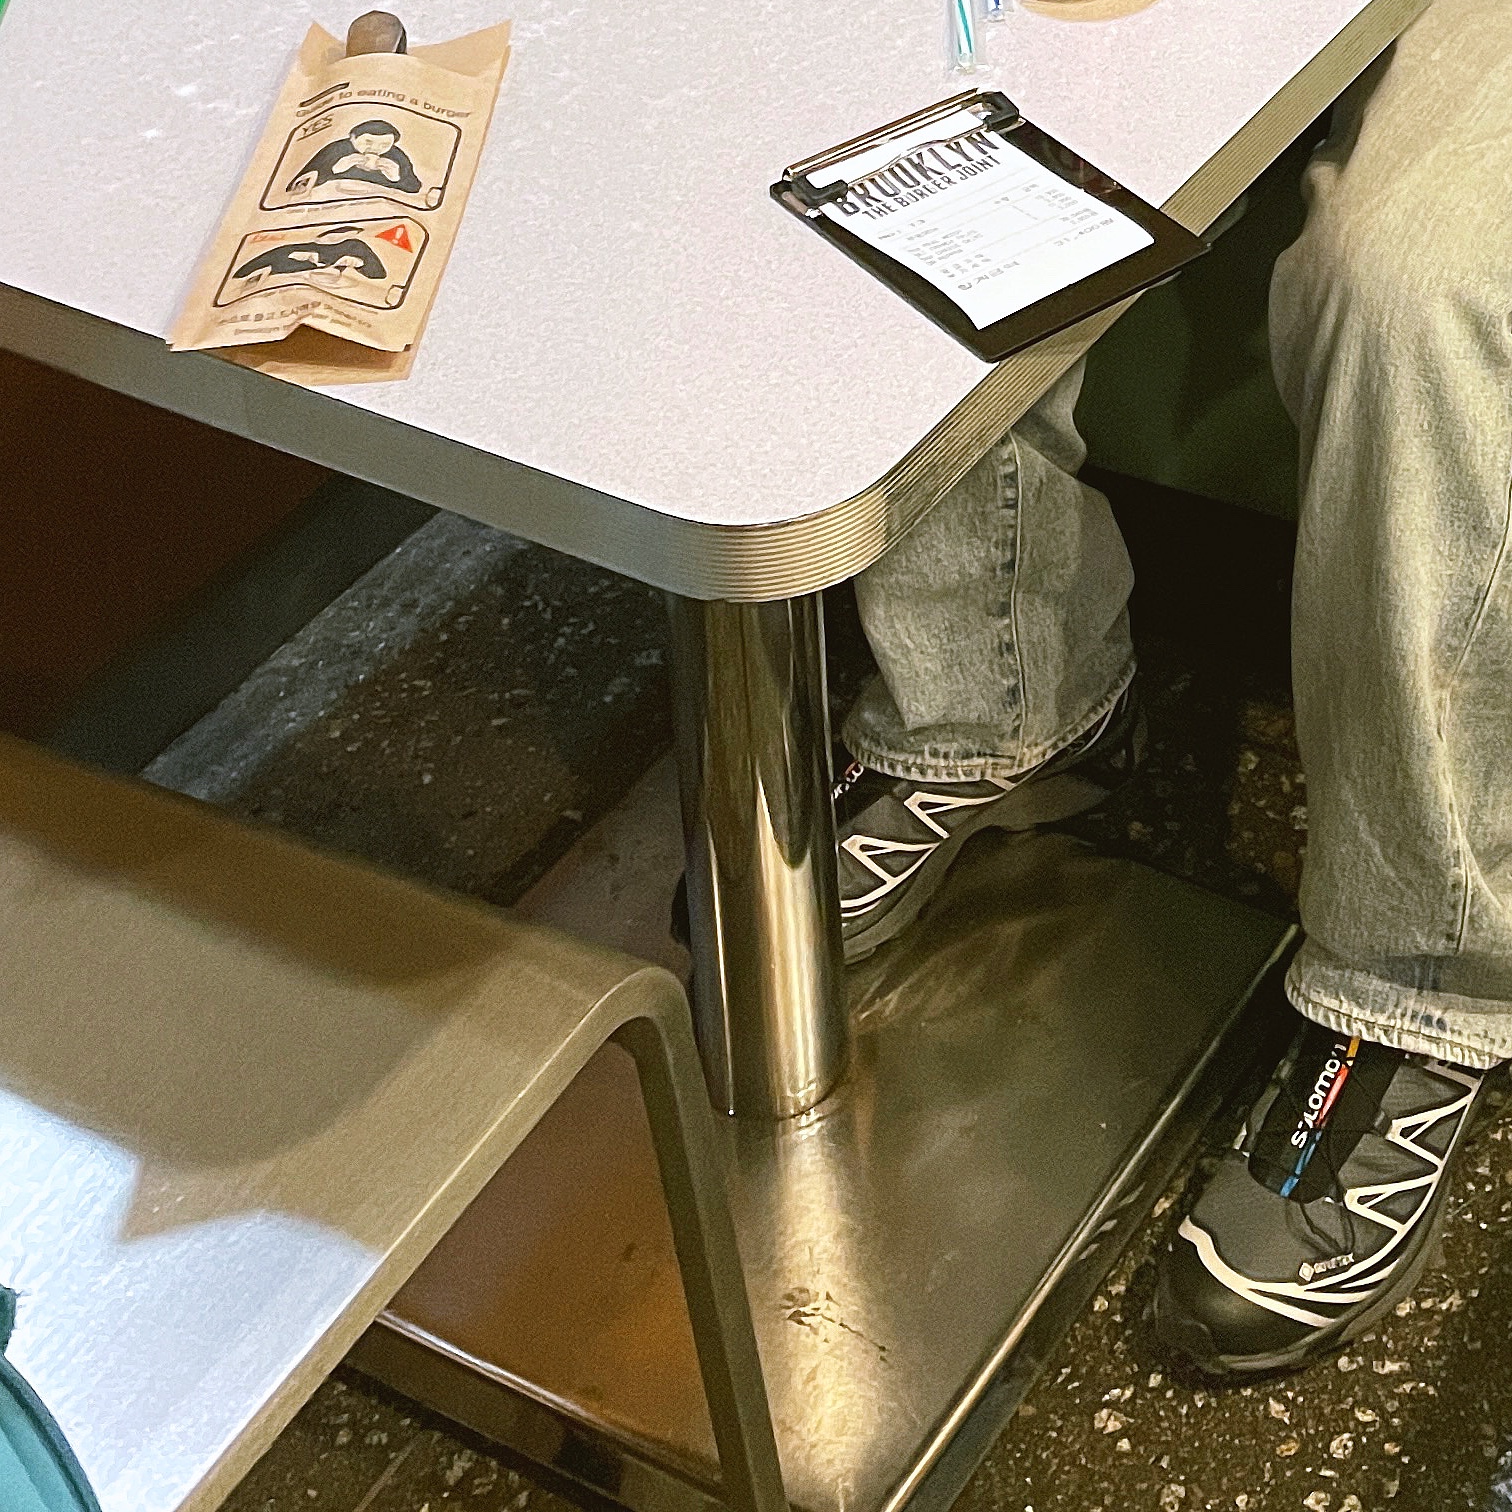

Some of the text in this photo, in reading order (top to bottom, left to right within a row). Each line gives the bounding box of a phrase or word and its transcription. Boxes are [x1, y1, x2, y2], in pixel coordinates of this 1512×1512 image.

[338, 91, 353, 100] to
[357, 89, 407, 102] eating
[410, 97, 418, 106] a
[423, 102, 472, 118] burger
[302, 113, 335, 135] YES
[862, 155, 1001, 220] THE BURGER JOINT
